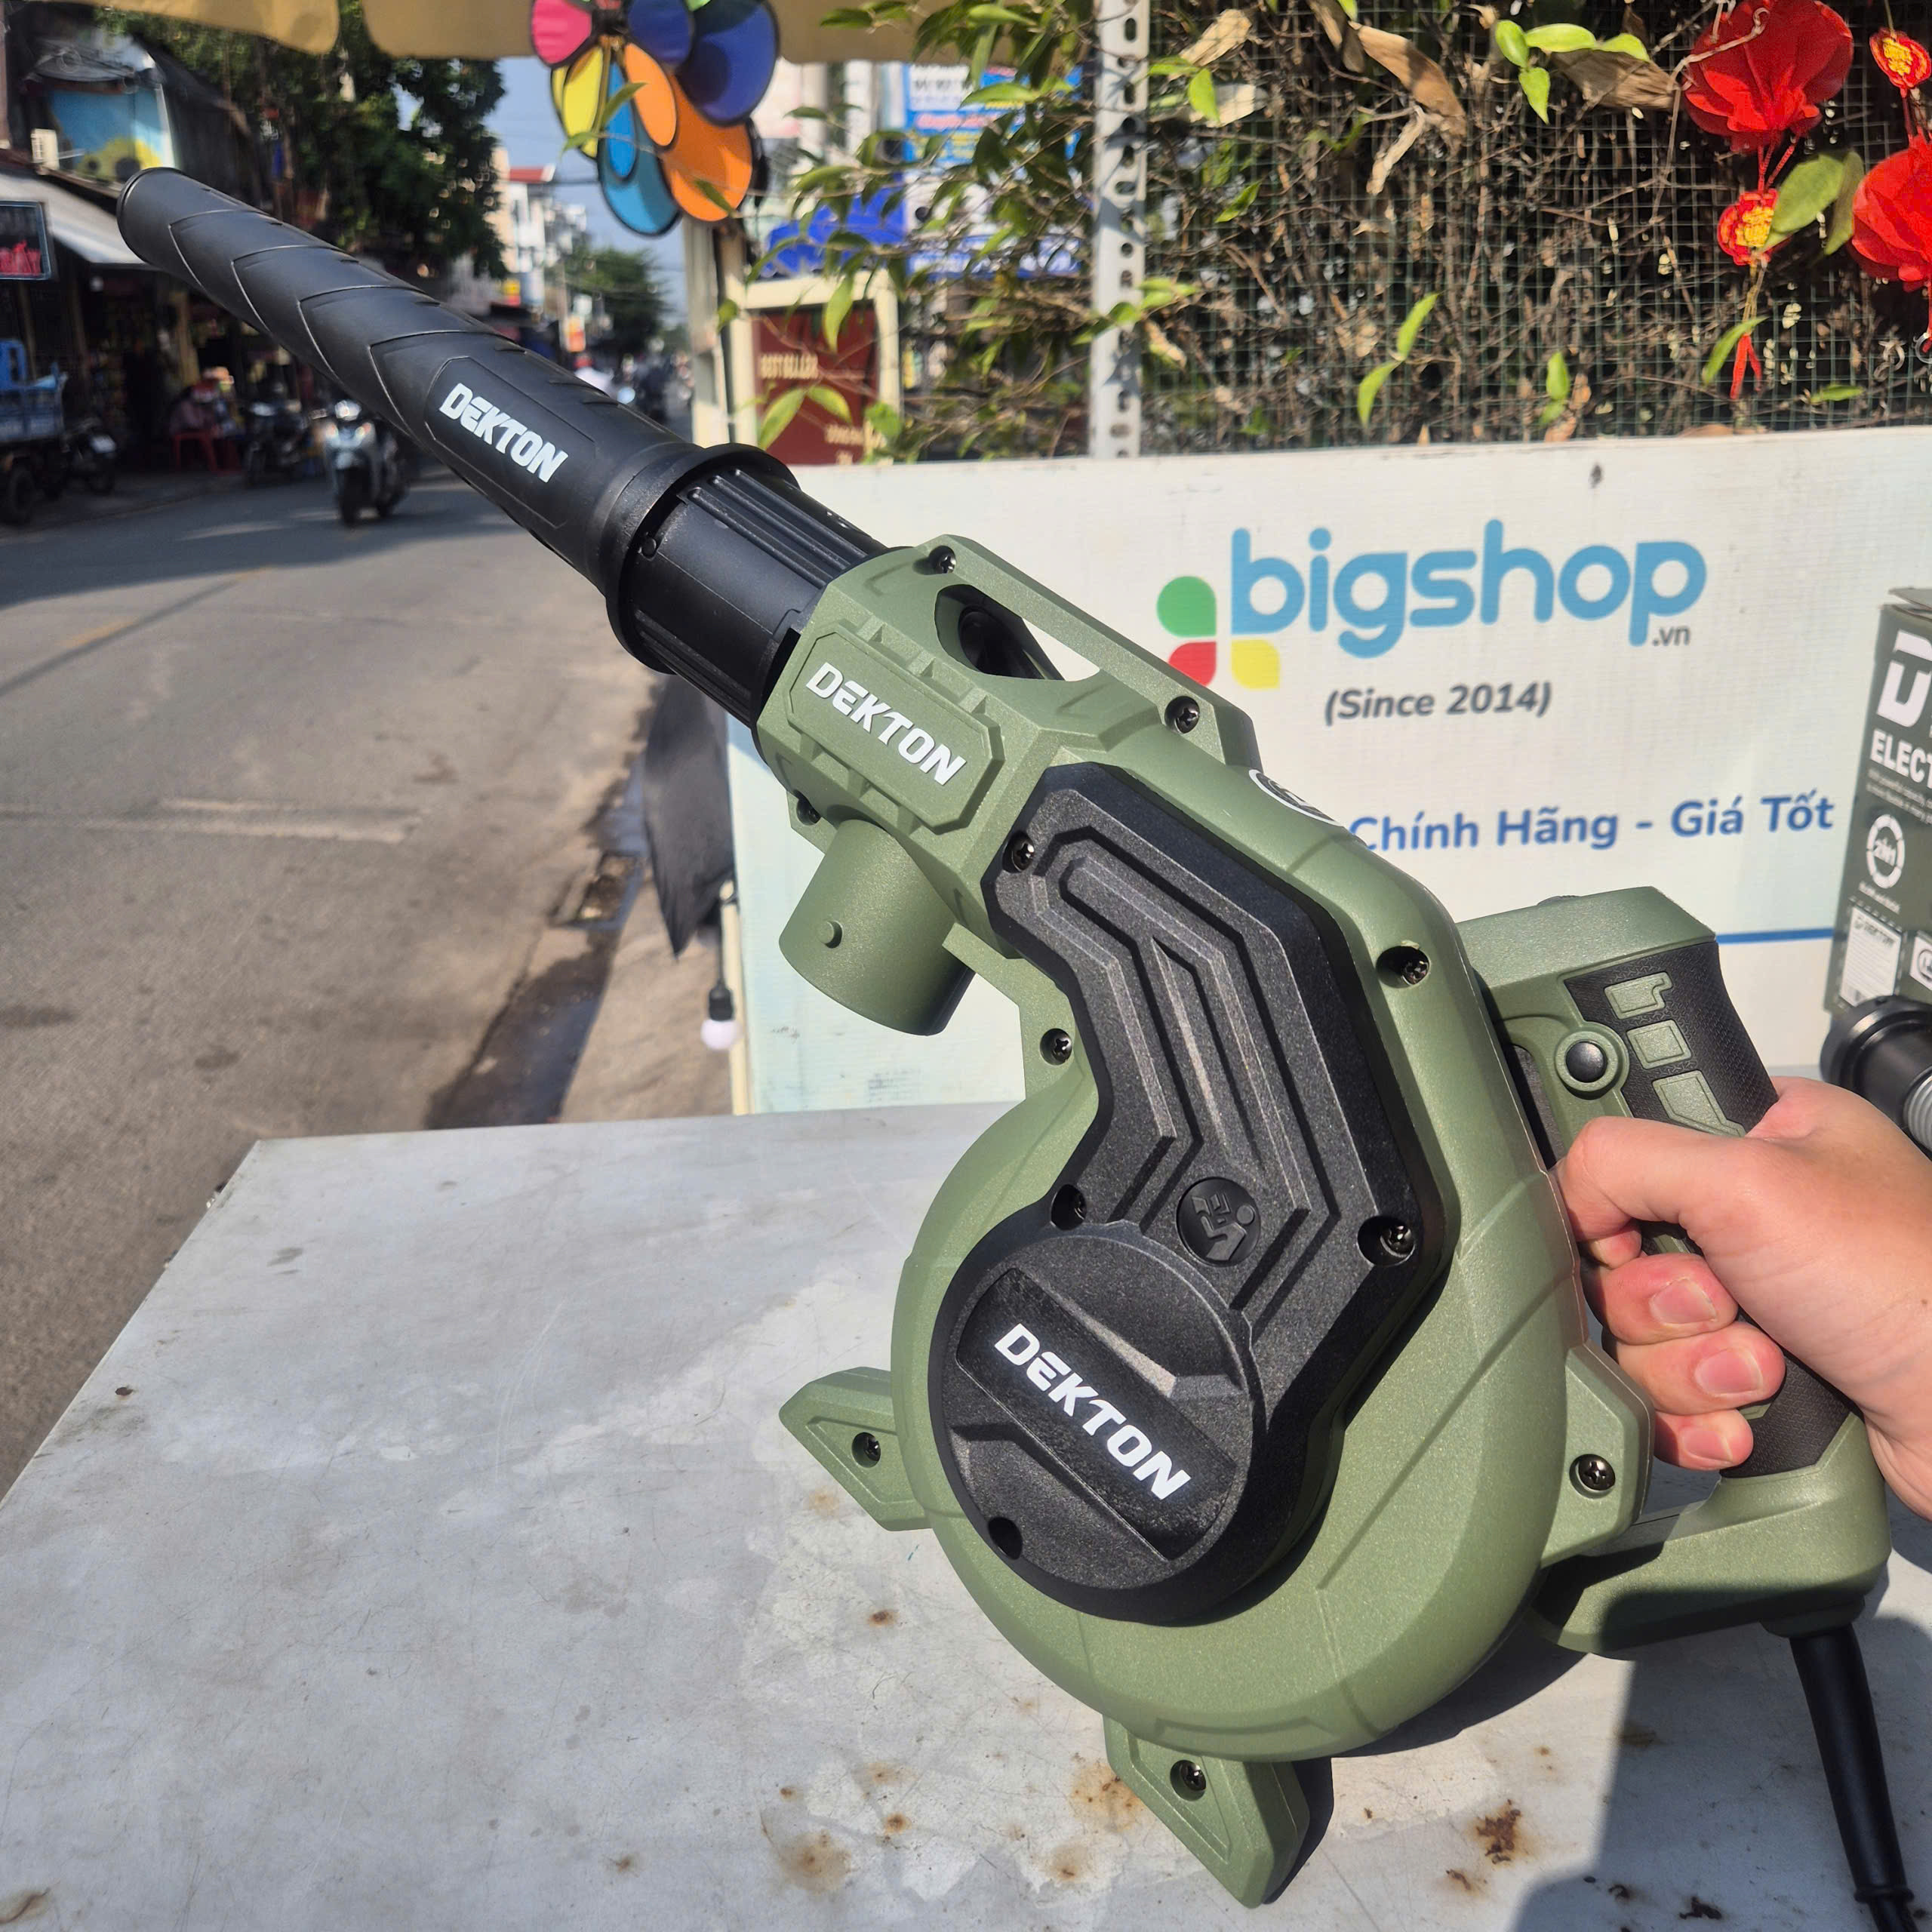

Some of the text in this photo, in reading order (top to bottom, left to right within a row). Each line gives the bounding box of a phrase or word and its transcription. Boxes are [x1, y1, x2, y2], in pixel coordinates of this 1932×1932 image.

[439, 383, 569, 483] DEKTON
[1230, 518, 1707, 659] bigshop
[1651, 626, 1690, 647] .vn
[805, 661, 967, 786] DEKTON
[1324, 681, 1552, 726] (Since 2014)
[1348, 810, 1479, 852] Chính
[1496, 805, 1619, 851] Hãng
[1670, 794, 1744, 838] Giá
[1760, 789, 1835, 832] Tốt
[994, 1323, 1192, 1500] DEKTON
